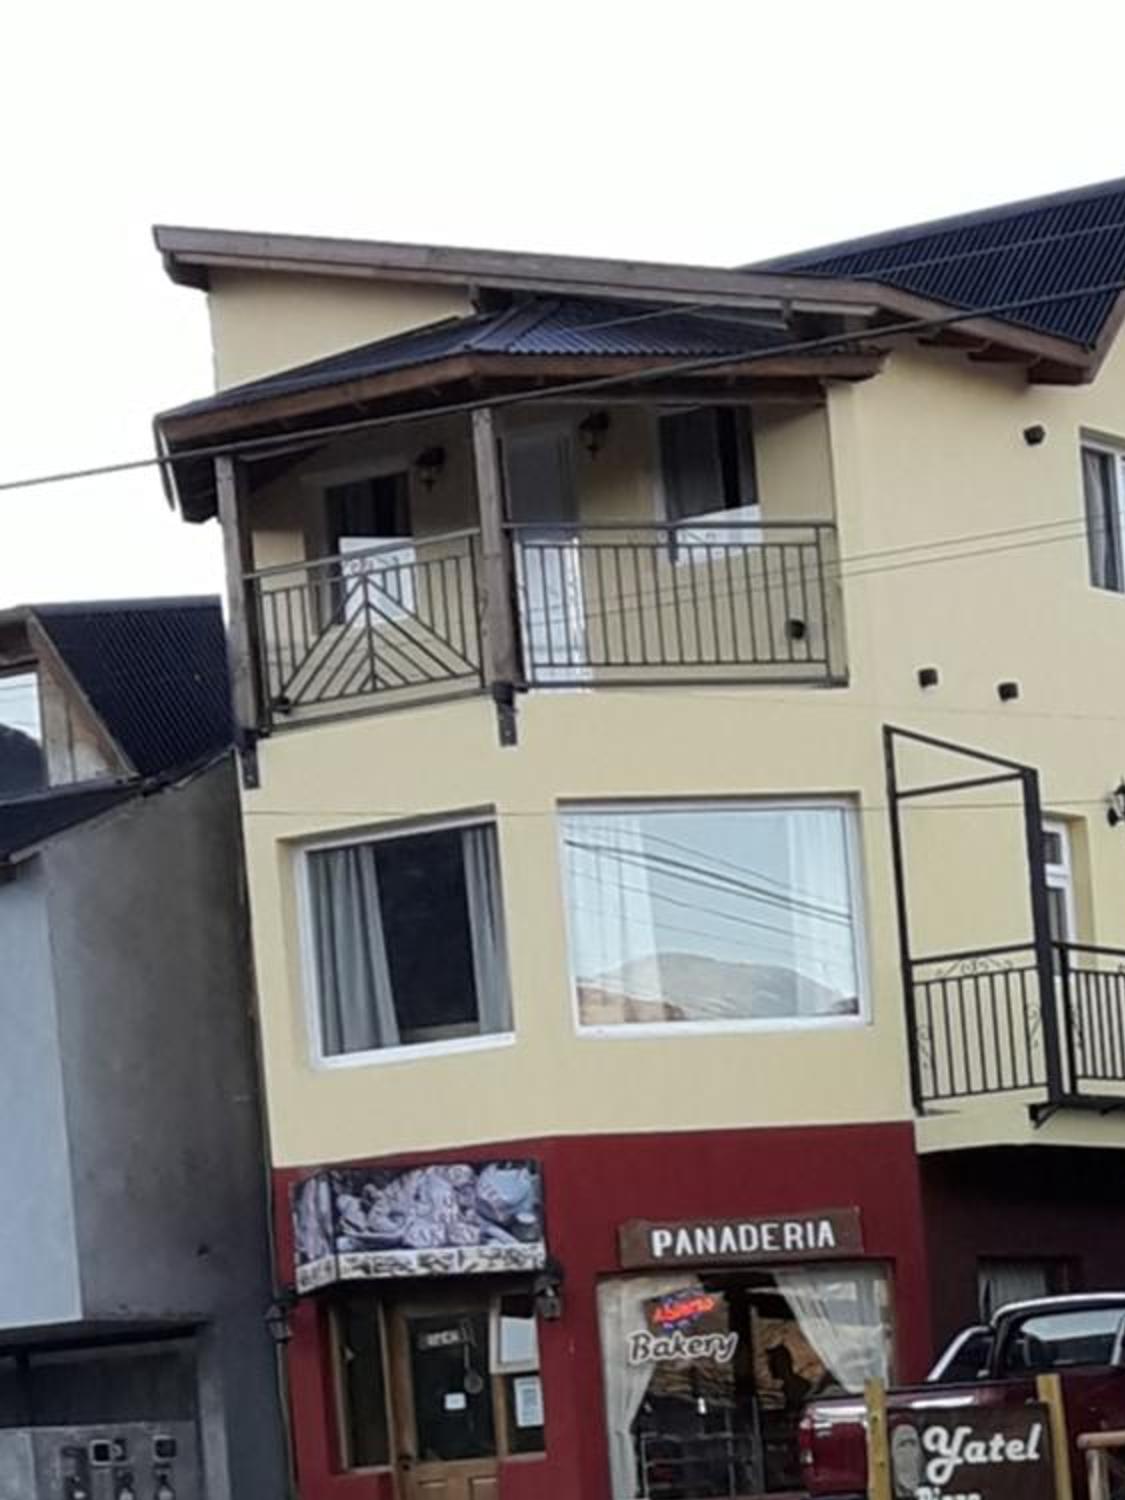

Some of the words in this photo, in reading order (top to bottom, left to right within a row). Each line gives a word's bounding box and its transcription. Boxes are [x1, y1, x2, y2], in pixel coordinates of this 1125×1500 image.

[651, 1220, 836, 1258] PANADERIA
[628, 1330, 738, 1366] Bakery
[922, 1422, 1042, 1485] Yatel
